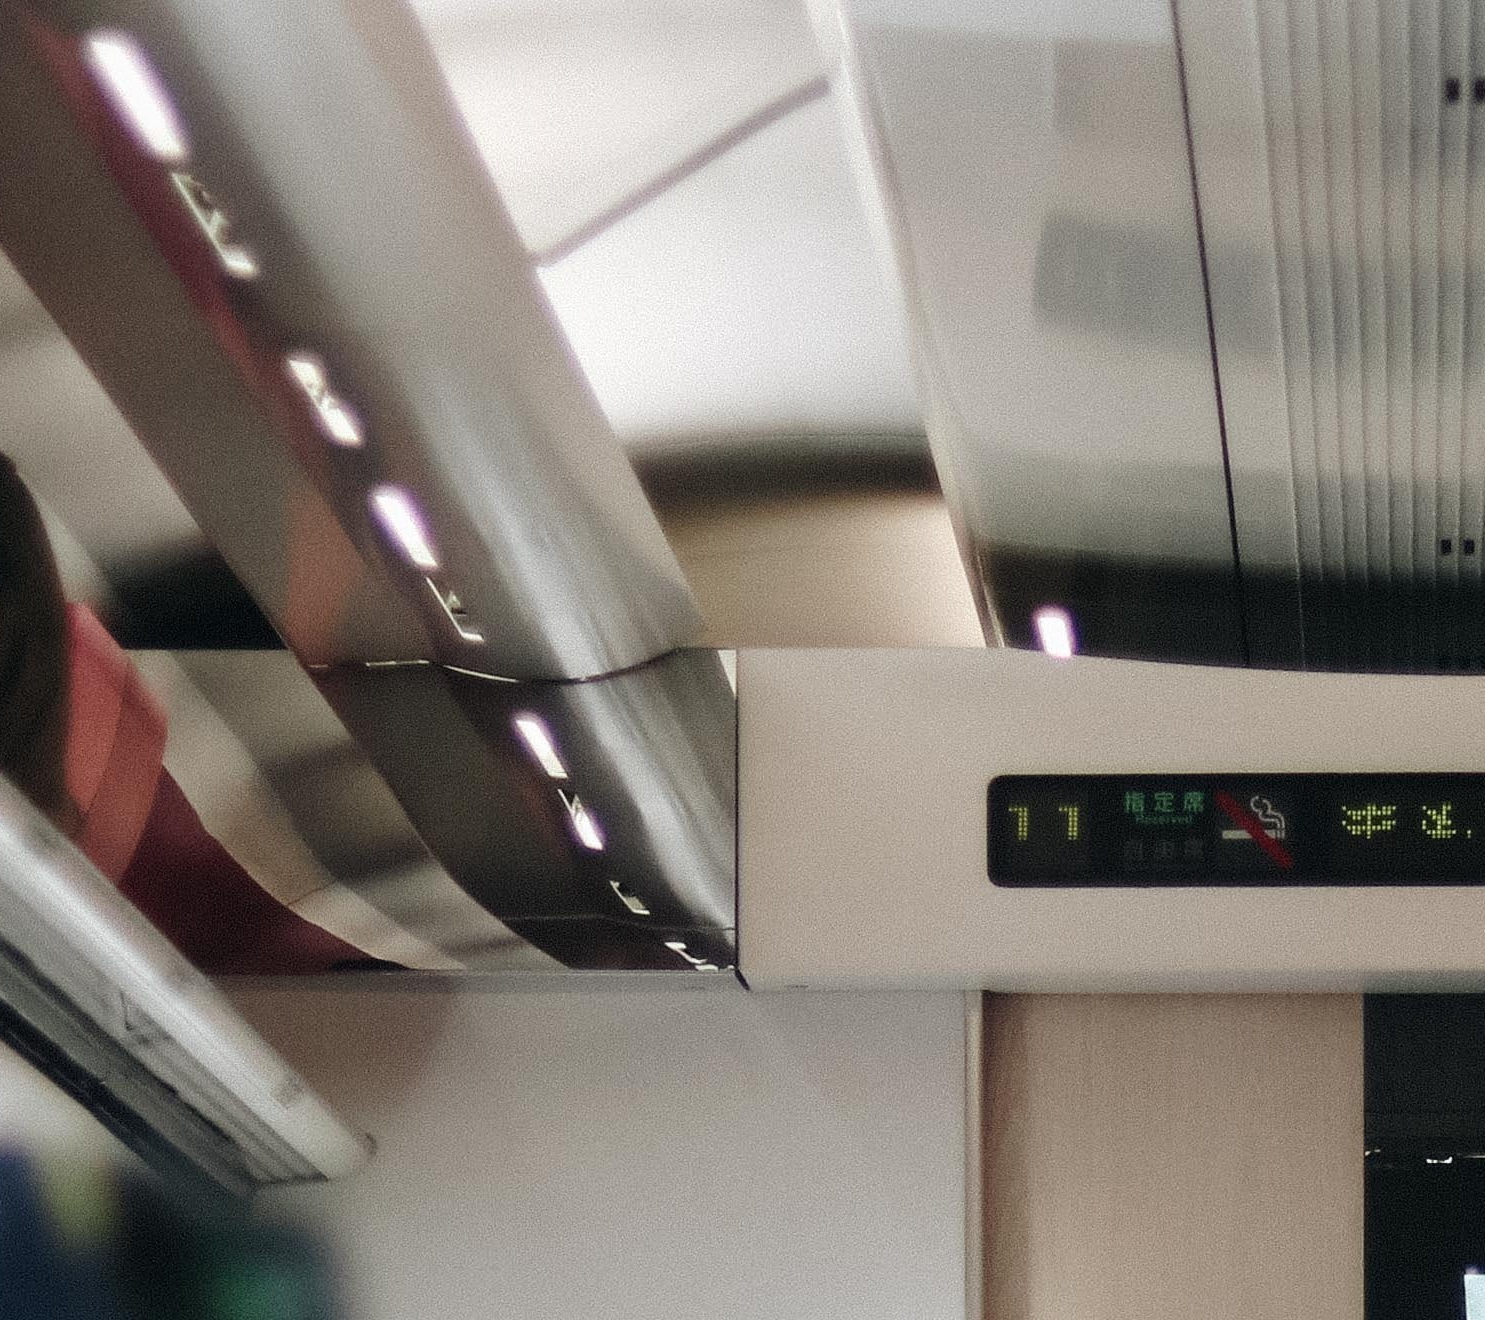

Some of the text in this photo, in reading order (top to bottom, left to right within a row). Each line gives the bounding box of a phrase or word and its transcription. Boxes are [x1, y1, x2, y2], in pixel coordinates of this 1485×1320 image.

[1123, 790, 1205, 813] 指定席
[1007, 805, 1079, 841] 11
